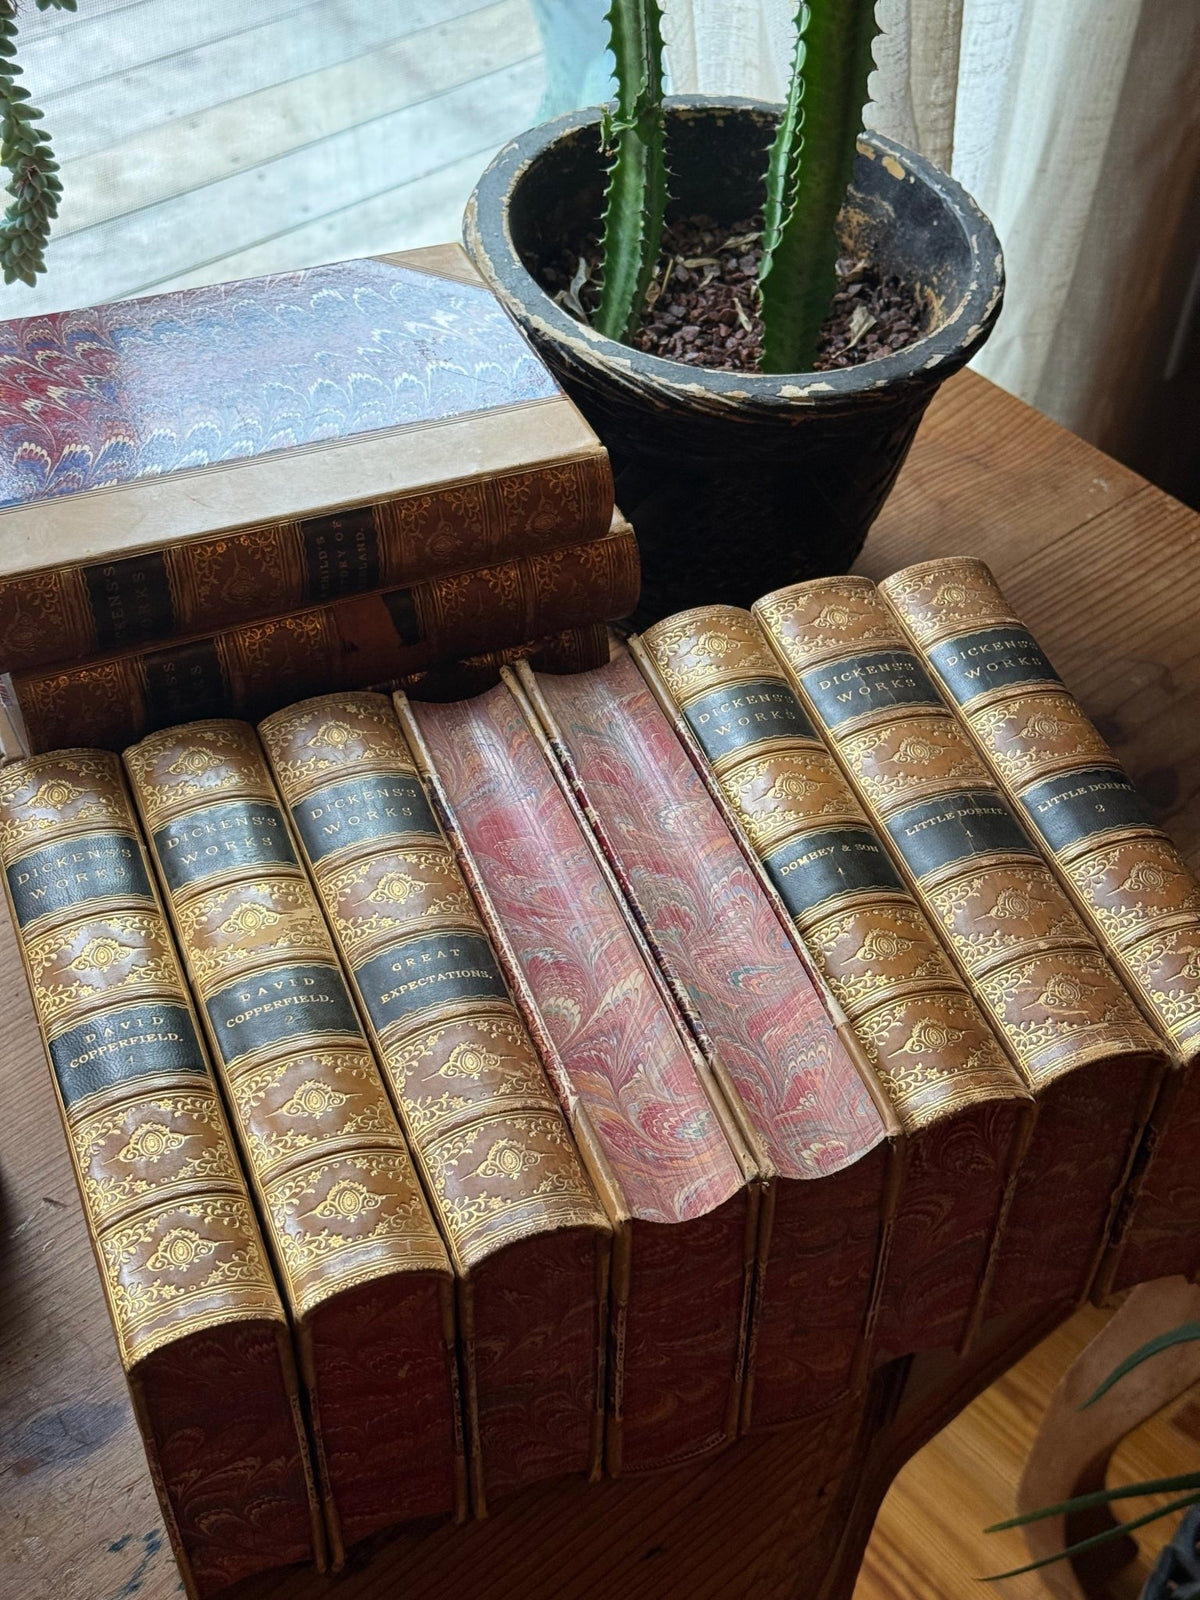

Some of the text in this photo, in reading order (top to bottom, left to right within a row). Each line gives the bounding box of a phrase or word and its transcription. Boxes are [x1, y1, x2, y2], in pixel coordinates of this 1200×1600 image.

[132, 571, 152, 633] ORKS
[819, 662, 915, 690] DICKENS'S
[964, 657, 1042, 679] WORKS
[836, 679, 916, 703] WORKS
[715, 708, 796, 736] WORKS
[311, 788, 417, 820] DICKENS'S
[1037, 787, 1088, 813] LITTLE
[1095, 804, 1105, 813] 2
[167, 816, 277, 849] DICKENS'S
[323, 807, 412, 834] WORKS
[904, 812, 955, 837] LITTLE
[965, 830, 974, 838] 1
[181, 837, 273, 865] WORKS
[780, 843, 879, 877] DOMBEY & SON
[17, 848, 131, 885] DICKENS'S
[837, 867, 846, 875] 1
[29, 867, 125, 899] WORKS
[391, 948, 460, 972] GREAT
[240, 977, 315, 1002] DAVID
[380, 970, 493, 1004] EXPECTATIONS.
[226, 994, 334, 1028] COPPERFIELD.
[285, 1015, 295, 1026] 2
[85, 1016, 163, 1043] DAVID
[70, 1033, 183, 1068] COPPERFIELD.
[127, 1055, 135, 1064] 1
